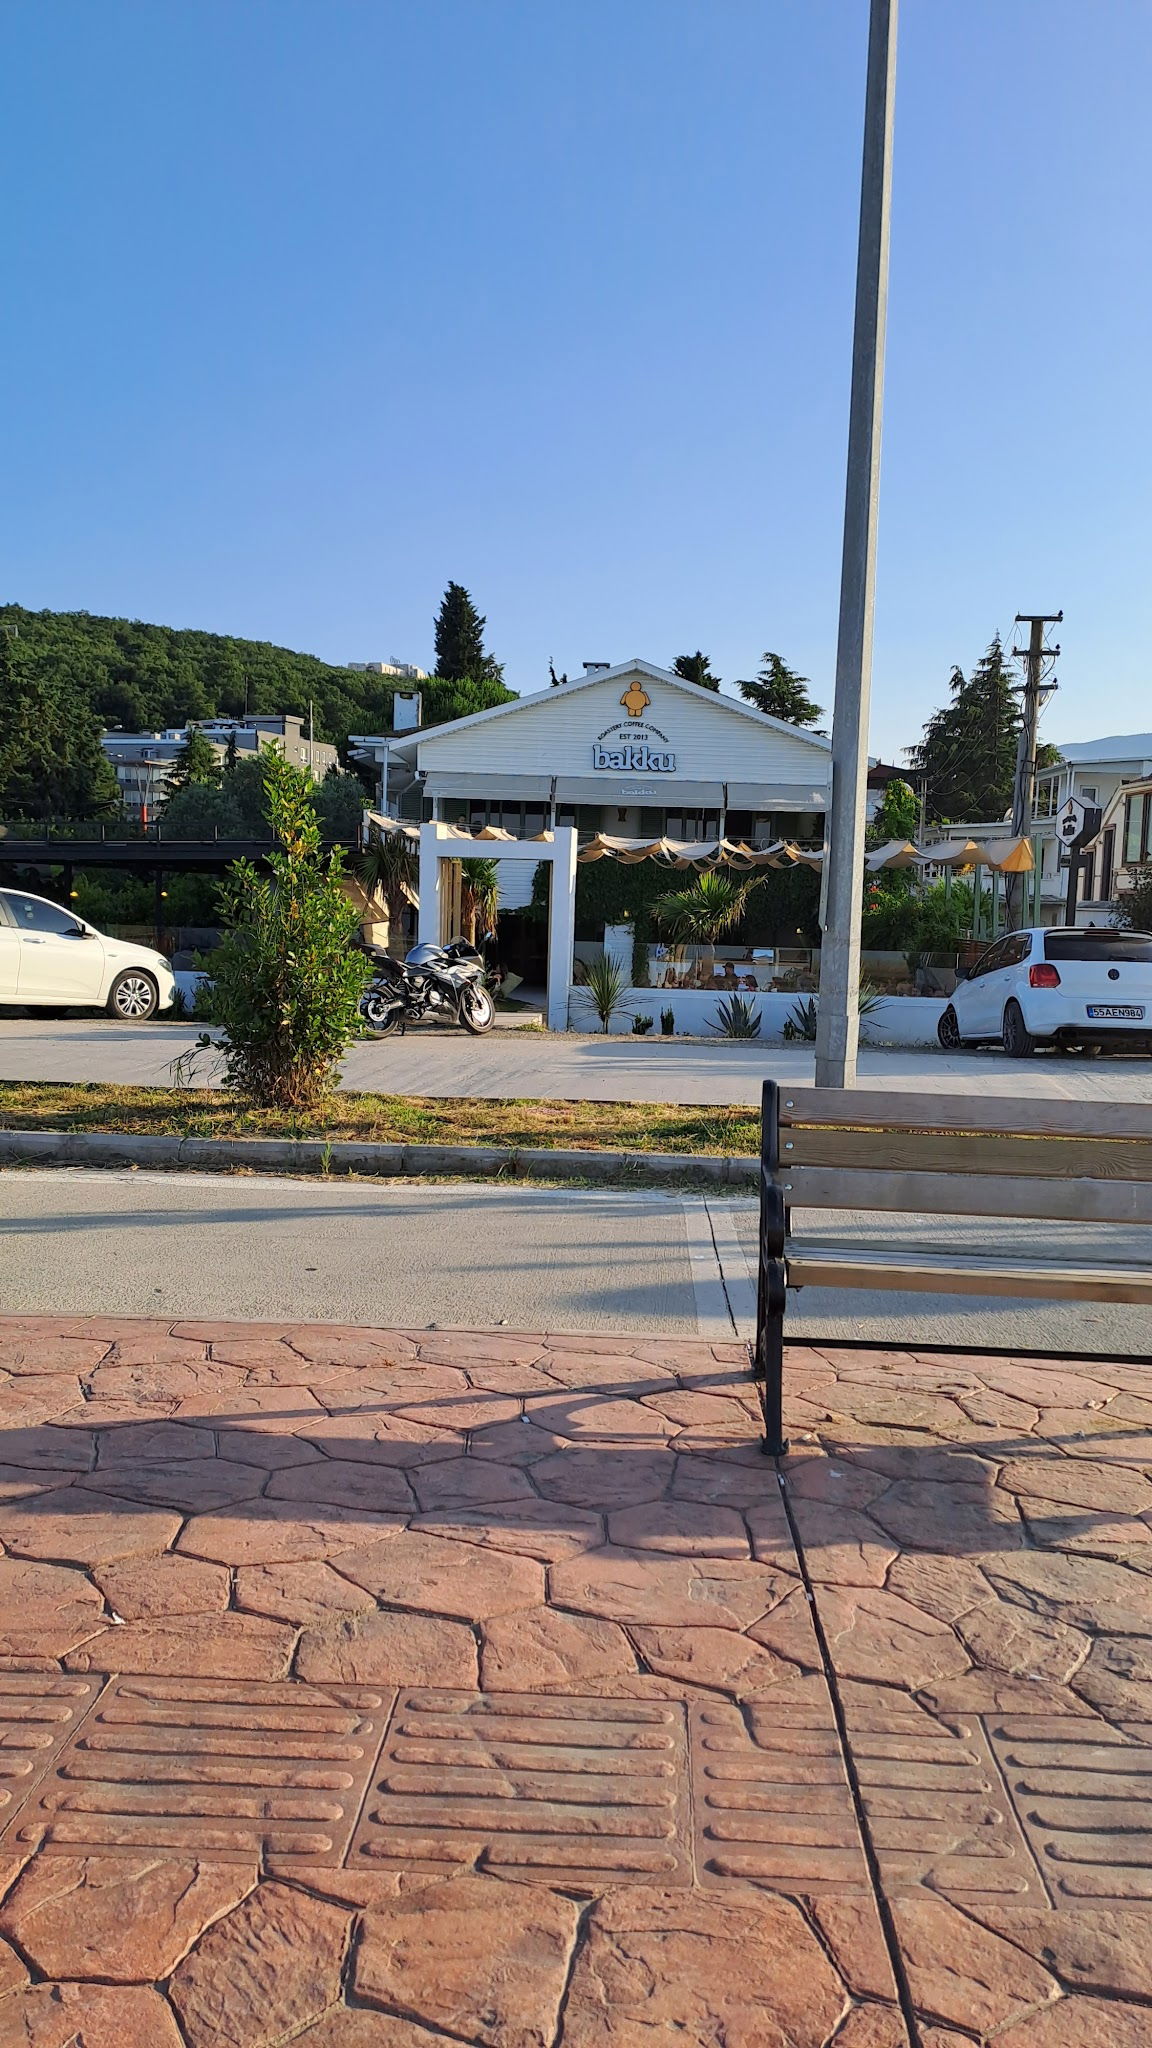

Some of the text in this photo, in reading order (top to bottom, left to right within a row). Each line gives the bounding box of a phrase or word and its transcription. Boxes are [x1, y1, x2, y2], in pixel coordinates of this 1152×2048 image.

[597, 722, 622, 741] ROASTERY
[645, 723, 670, 744] COMPANY
[633, 733, 648, 741] 2013
[593, 744, 676, 772] bakku
